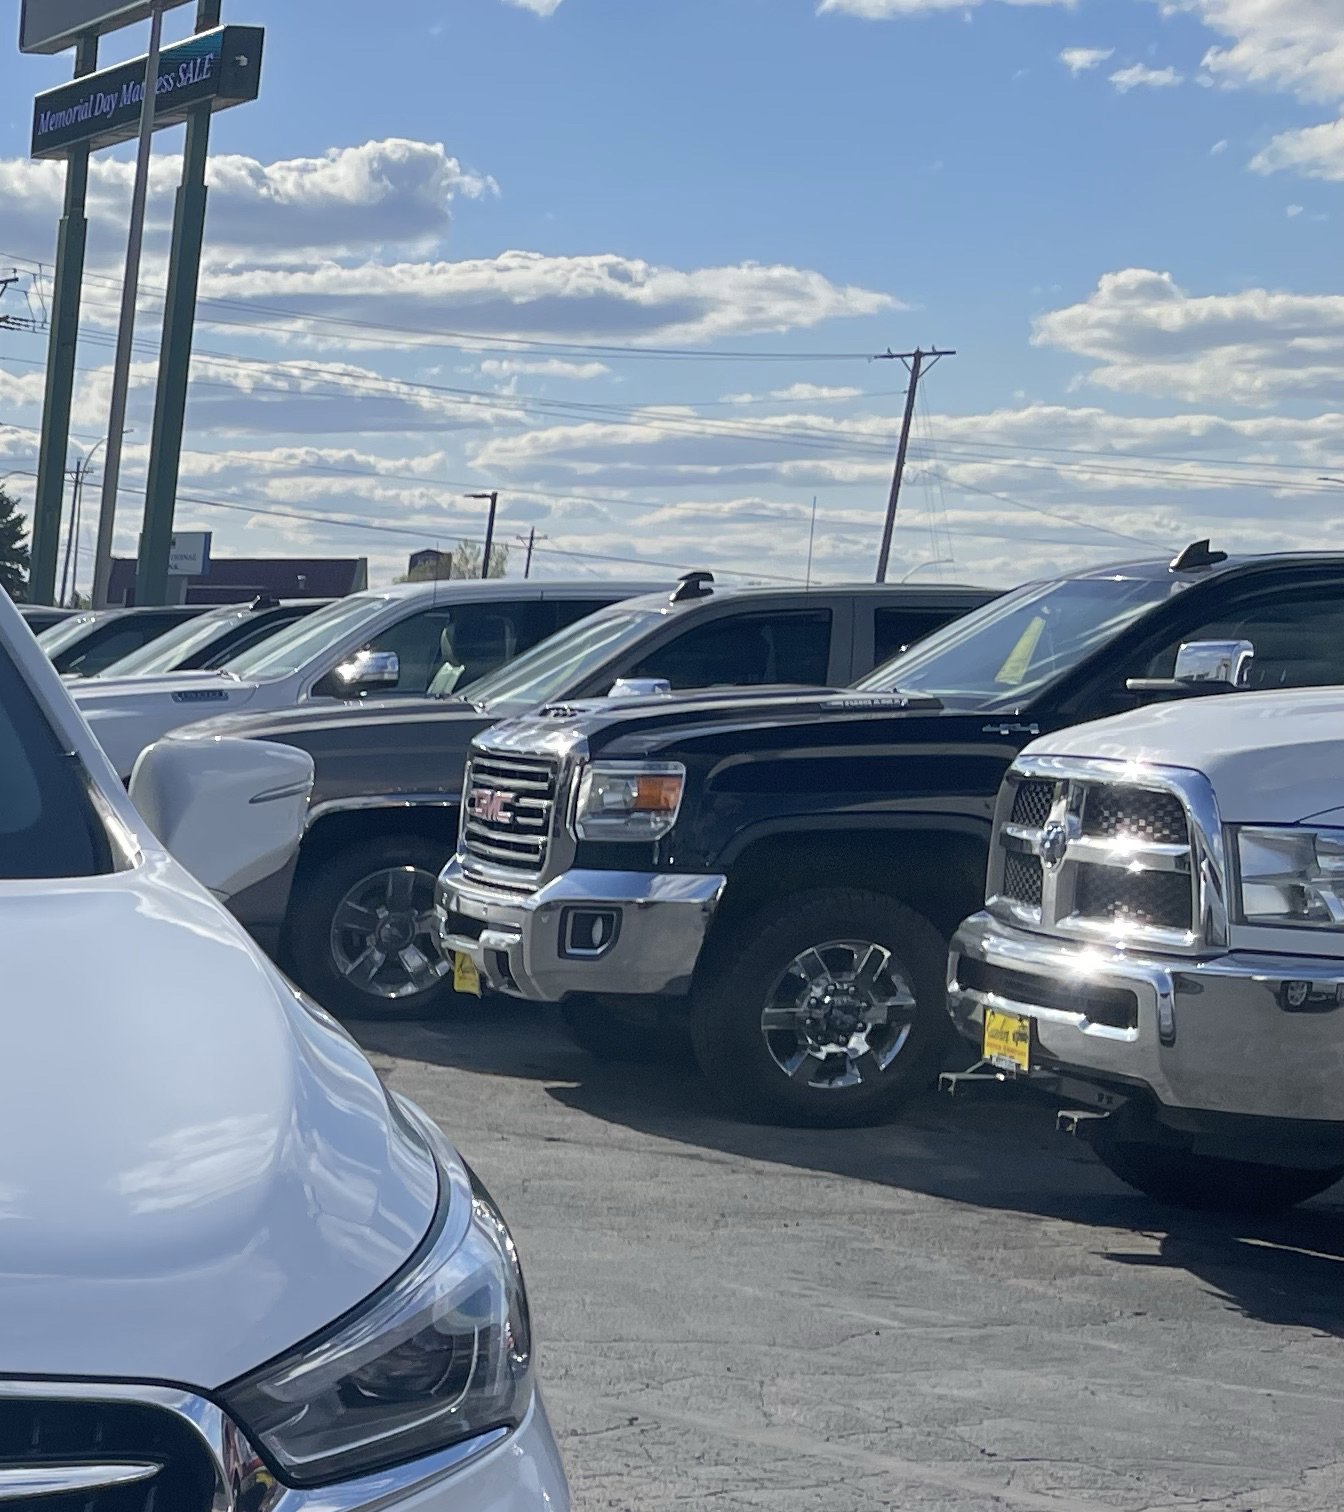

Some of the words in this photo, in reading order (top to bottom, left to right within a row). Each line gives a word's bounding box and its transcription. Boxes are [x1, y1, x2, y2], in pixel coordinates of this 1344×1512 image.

[38, 94, 93, 135] Memorial
[94, 92, 119, 118] Day
[119, 72, 176, 108] Matess
[176, 53, 214, 88] SALE
[471, 788, 514, 824] GMC
